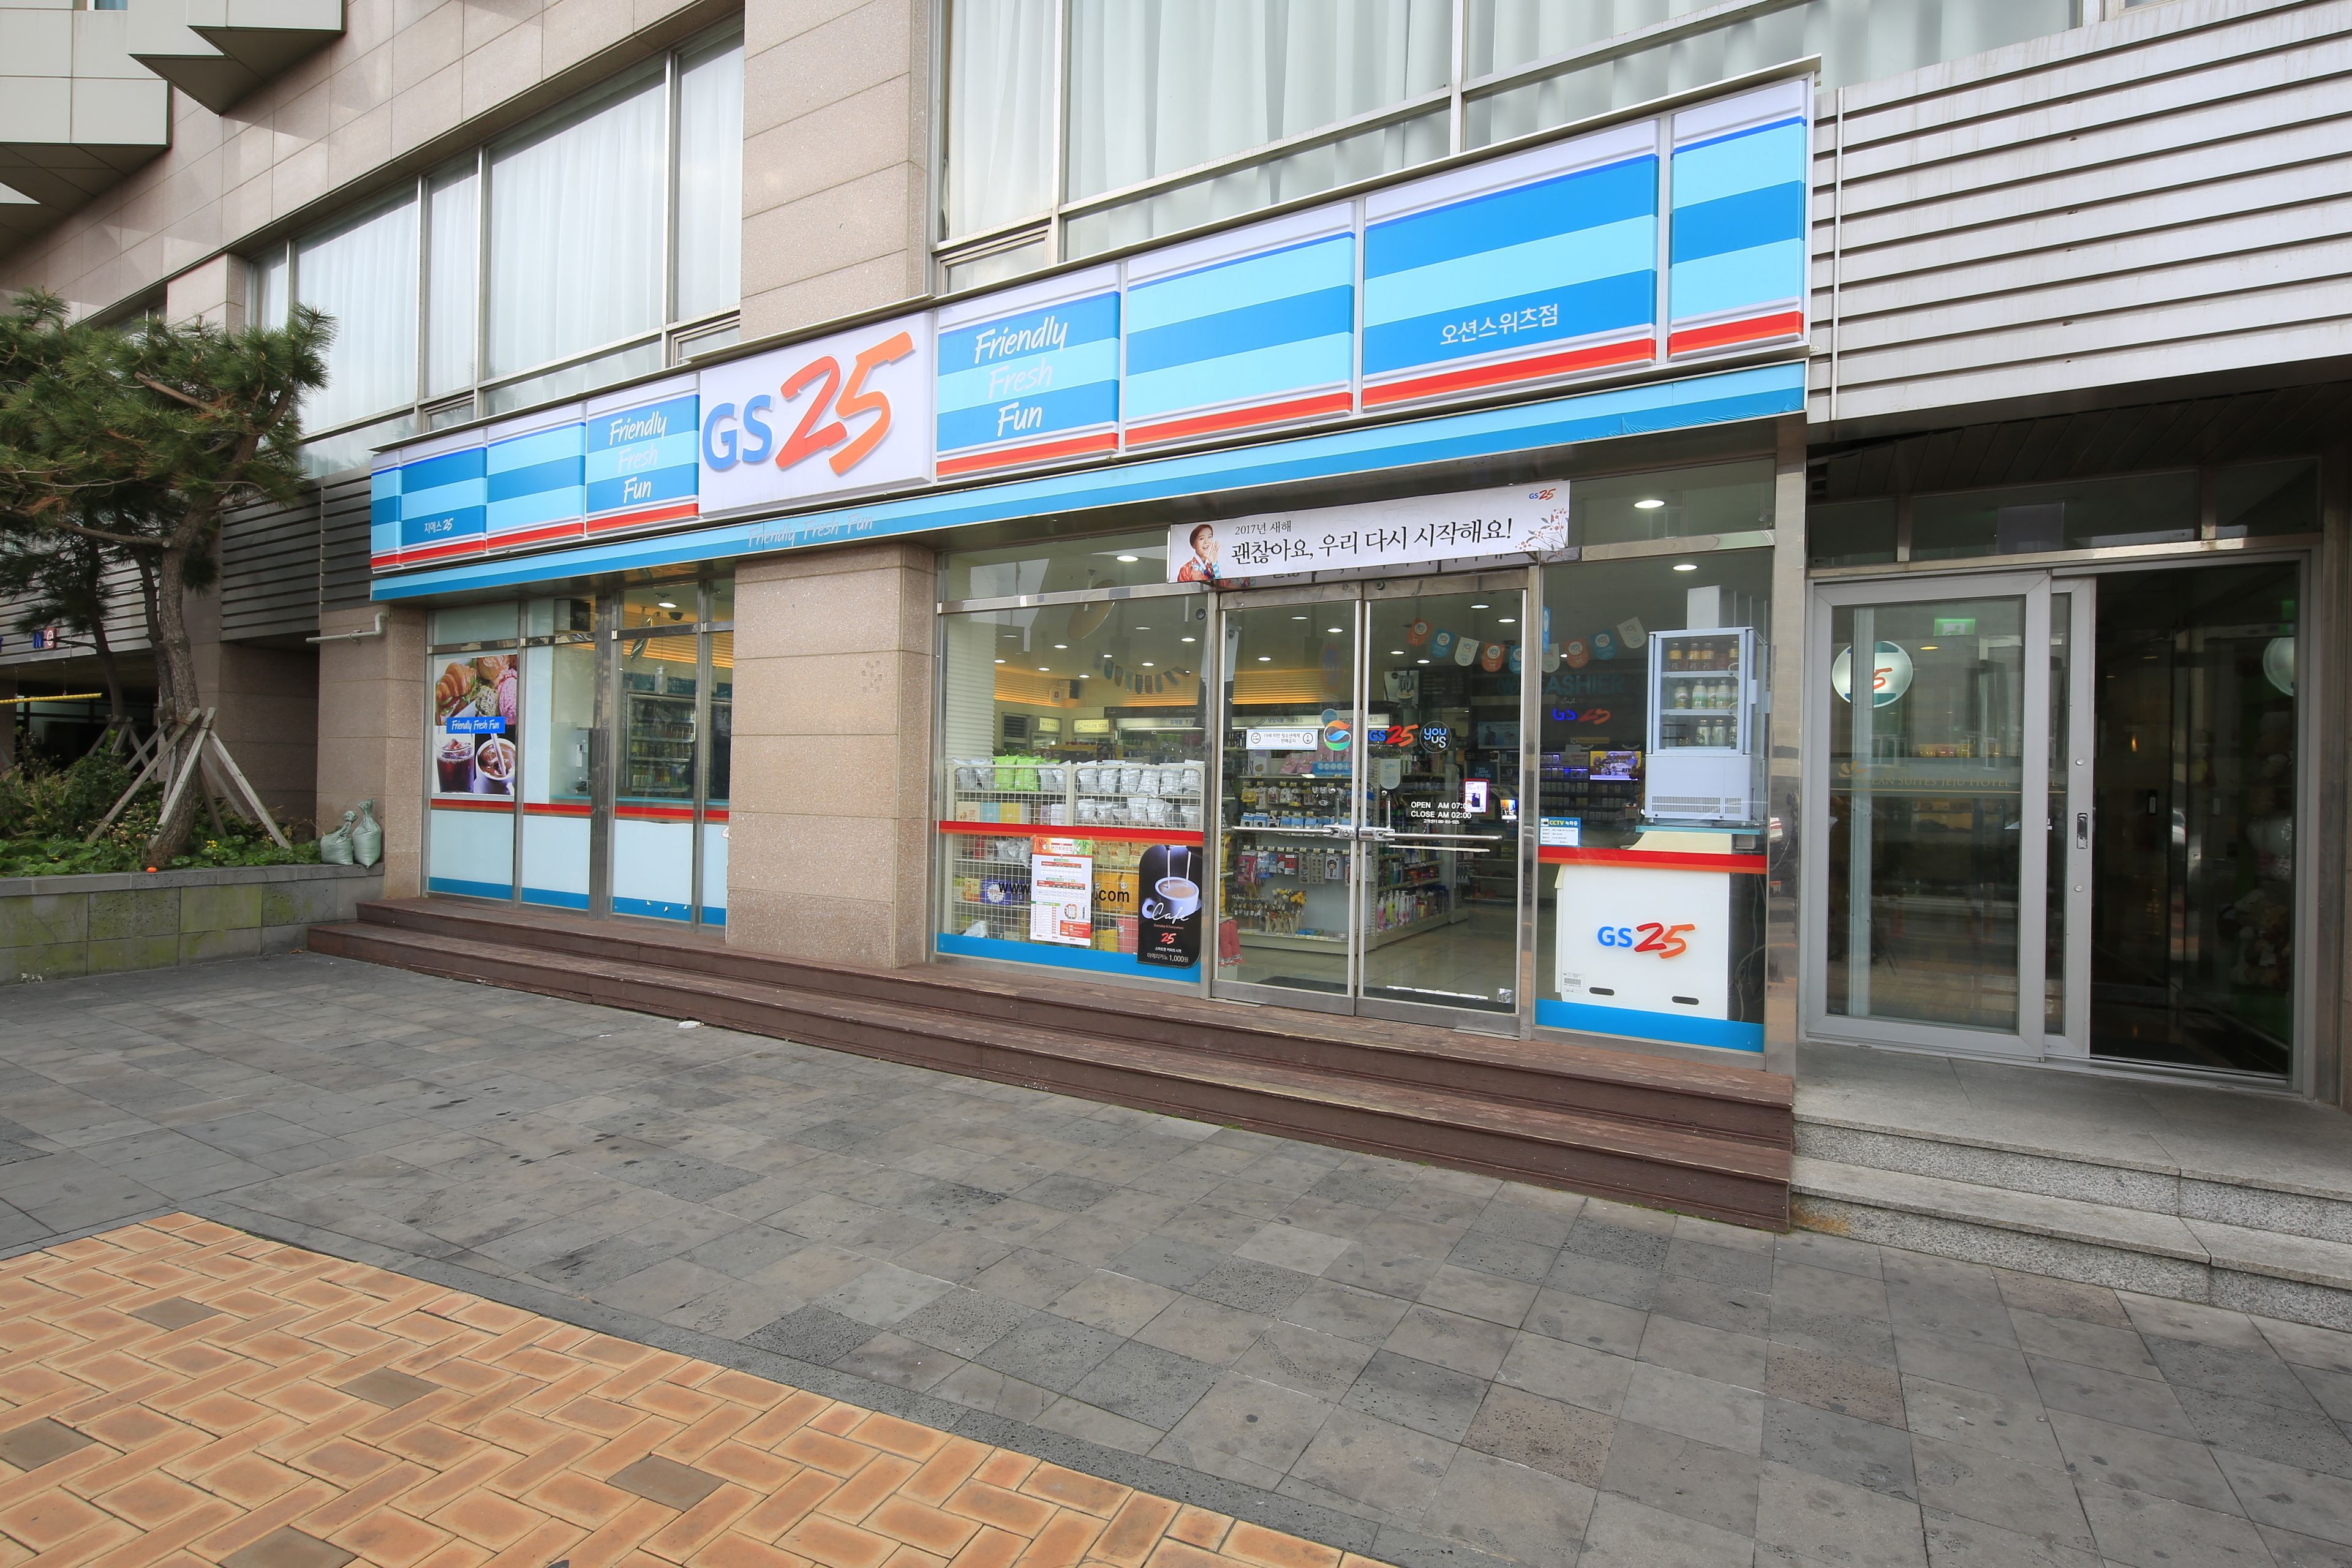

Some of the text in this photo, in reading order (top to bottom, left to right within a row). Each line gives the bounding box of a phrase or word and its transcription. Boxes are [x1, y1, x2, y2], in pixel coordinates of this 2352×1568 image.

[974, 315, 1068, 364] Friendly
[1440, 303, 1558, 345] 오션스위츠점
[988, 356, 1053, 399] Fresh
[702, 331, 916, 475] GS25
[609, 410, 667, 445] Friendly
[997, 401, 1042, 437] Fun
[618, 443, 658, 474] Fresh
[623, 477, 652, 503] Fun
[1529, 488, 1556, 500] GS25
[748, 513, 873, 548] Friendly Fresh Fun
[1231, 518, 1512, 565] 괜찮아요, 우리 다시 시작해요!
[1235, 520, 1292, 535] 2017년 새해
[451, 719, 499, 733] Friendly Fresh Fun
[1368, 724, 1419, 747] GS25
[1423, 728, 1447, 740] you
[1095, 889, 1129, 903] .com
[1152, 902, 1189, 924] Cafe
[1161, 932, 1176, 944] 25
[1597, 922, 1696, 959] GS25
